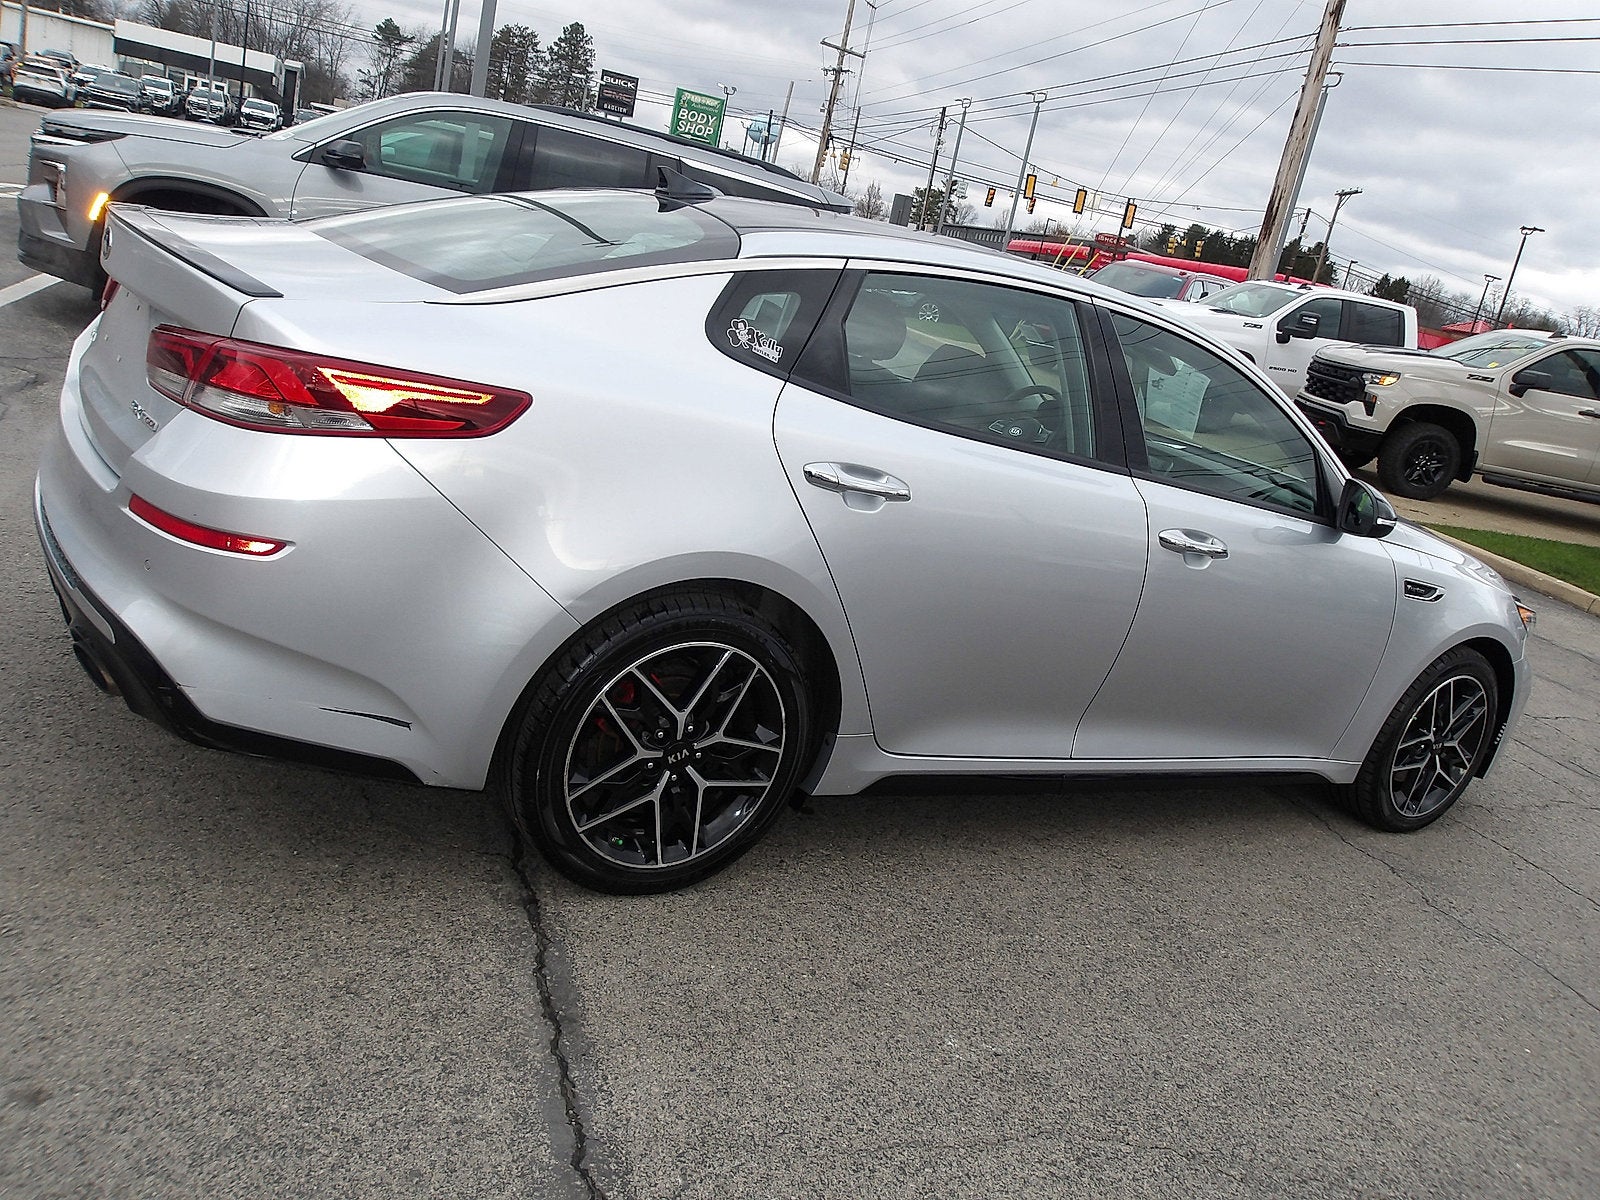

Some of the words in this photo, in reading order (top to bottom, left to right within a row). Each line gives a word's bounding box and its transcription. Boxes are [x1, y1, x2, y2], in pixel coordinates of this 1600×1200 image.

[603, 75, 636, 90] BUICK
[678, 107, 717, 126] BODY
[677, 120, 714, 138] SHOP
[755, 330, 782, 357] Kelly
[667, 748, 690, 765] KIA
